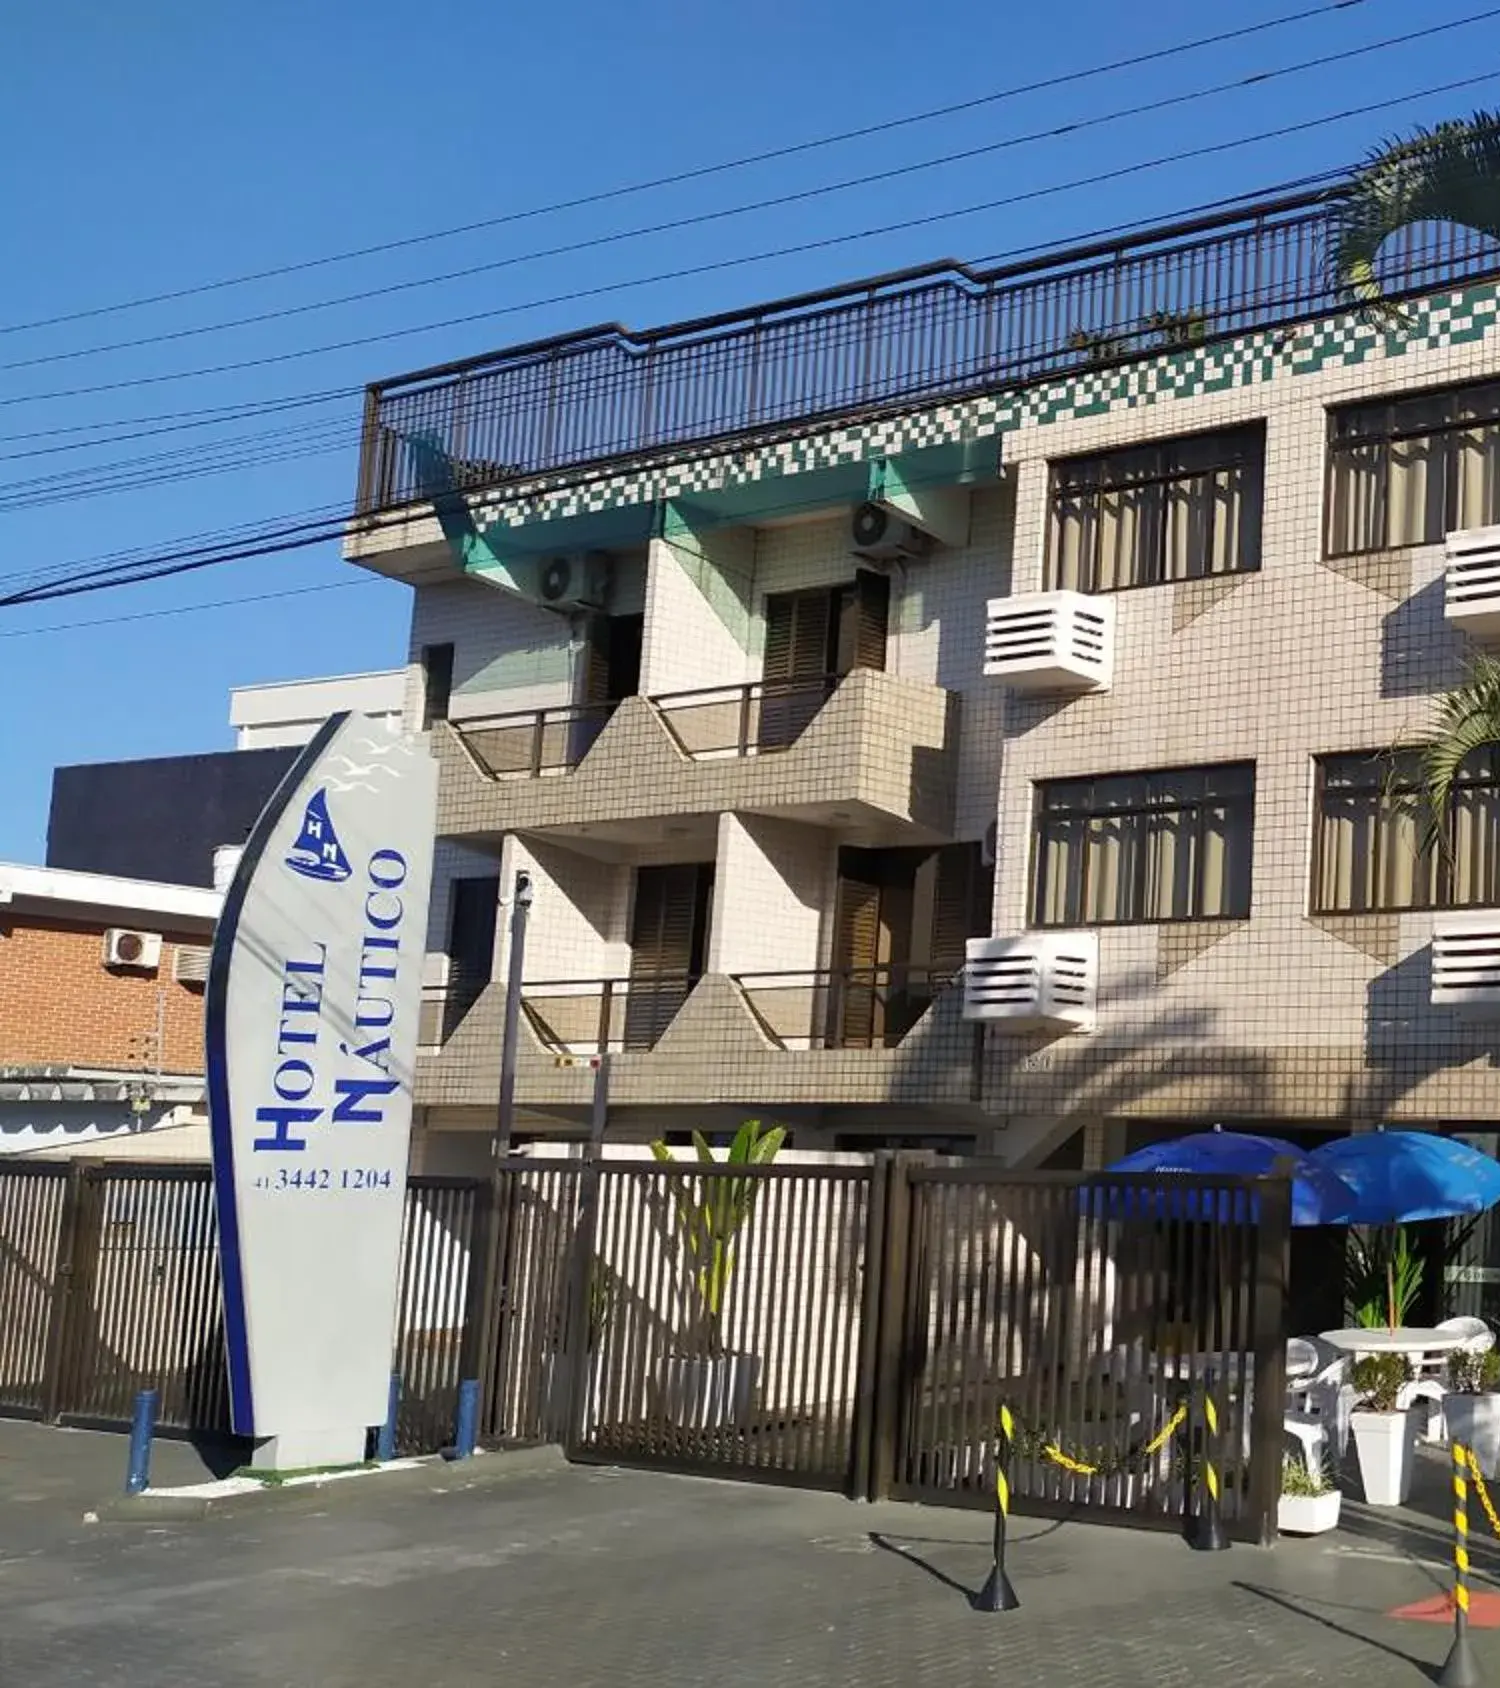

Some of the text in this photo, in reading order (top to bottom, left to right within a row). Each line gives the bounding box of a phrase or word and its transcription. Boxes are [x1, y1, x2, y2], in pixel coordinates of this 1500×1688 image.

[253, 941, 327, 1152] HOTEL
[332, 848, 406, 1124] NÁUTICO
[275, 1168, 330, 1190] 3442
[342, 1168, 391, 1190] 1204
